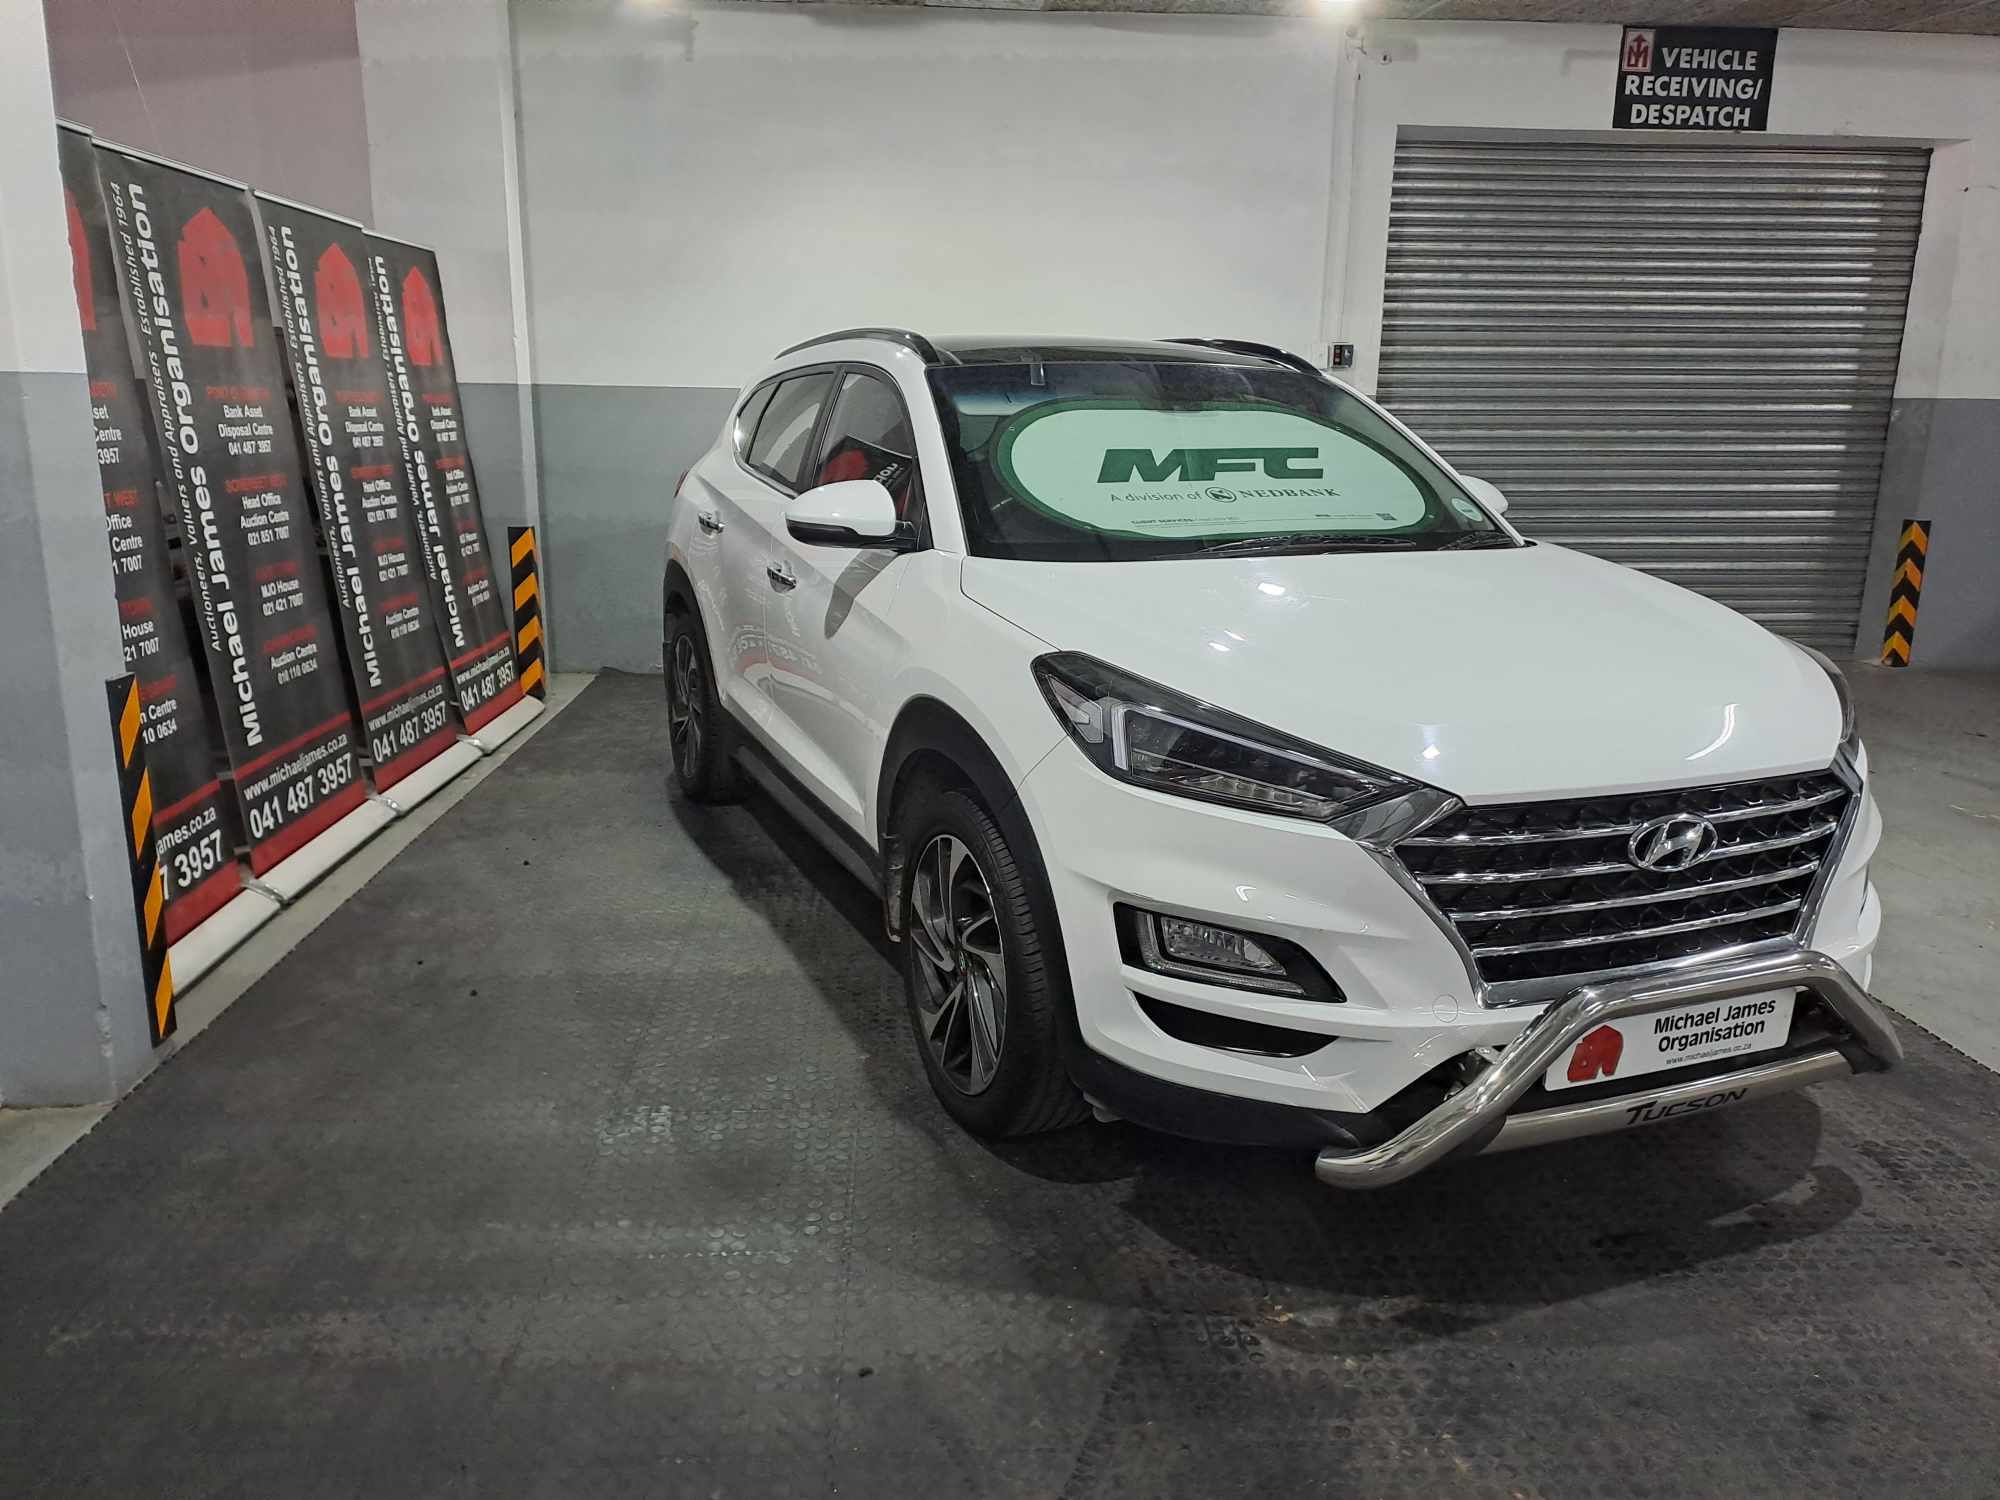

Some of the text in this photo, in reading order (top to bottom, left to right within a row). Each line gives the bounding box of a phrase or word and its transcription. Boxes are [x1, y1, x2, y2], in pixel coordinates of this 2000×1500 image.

[1662, 47, 1757, 71] VEHICLE
[1625, 75, 1763, 100] RECEIVING/
[1630, 104, 1751, 127] DESPATCH
[110, 181, 129, 227] 1964
[120, 231, 152, 336] Established
[375, 255, 419, 442] Organisation
[149, 351, 176, 443] Appraisers
[218, 423, 251, 440] Disposal
[128, 183, 263, 747] Michael James Organisation
[167, 445, 184, 480] and
[281, 225, 382, 688] Michael James Organisation
[308, 437, 322, 467] and
[1097, 447, 1324, 484] MFC
[414, 450, 440, 537] James
[1111, 488, 1341, 502] A division of NEDBANK
[178, 484, 197, 545] Valuers
[112, 535, 143, 552] Centre
[121, 555, 143, 573] 7007
[433, 545, 465, 648] Michael
[122, 620, 154, 640] House
[139, 637, 160, 656] 7007
[460, 661, 515, 711] 041 487 3957
[149, 698, 177, 720] Centre
[142, 727, 155, 745] 10
[373, 701, 447, 763] 041 487 3957
[243, 733, 348, 801] www.michaeljames.co.za
[249, 752, 353, 840] 041 487 3957
[174, 829, 221, 888] 3957
[1654, 1000, 1776, 1035] Michael James
[1658, 1020, 1765, 1053] Organisation
[1626, 1088, 1748, 1126] TUCSON
